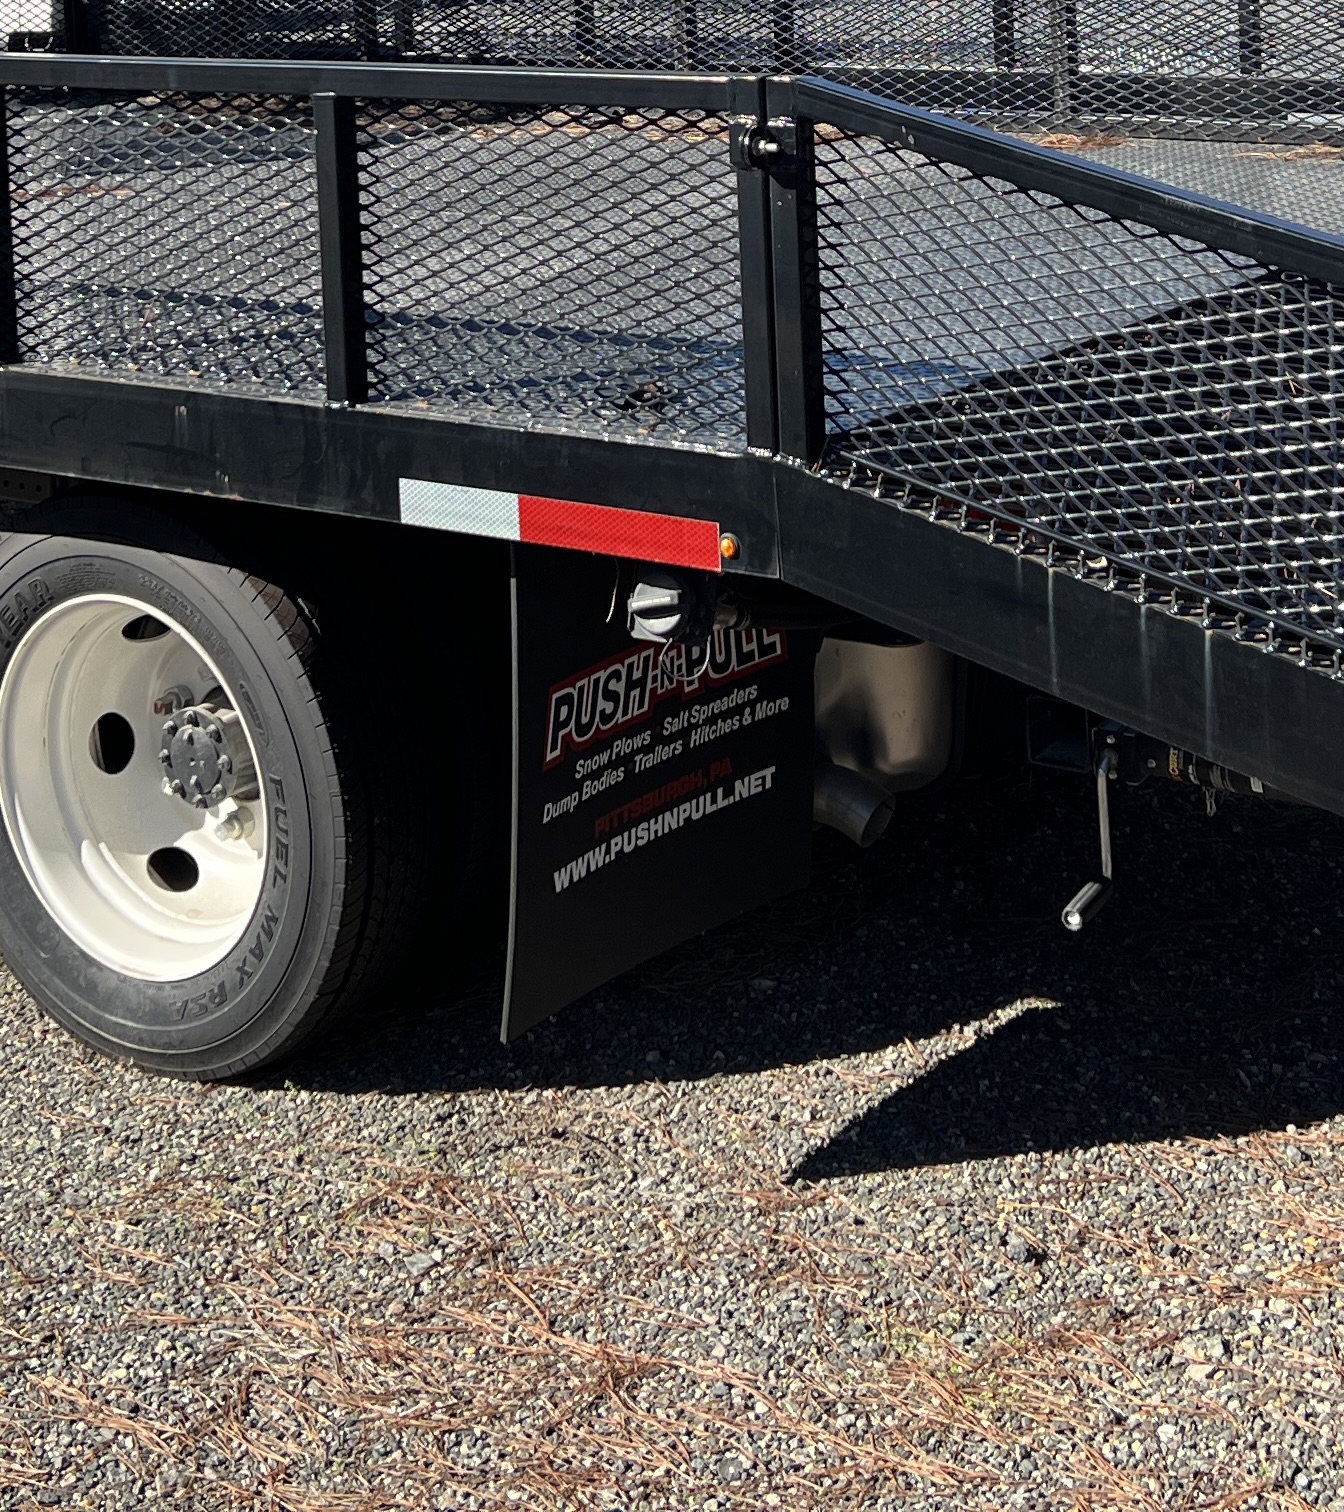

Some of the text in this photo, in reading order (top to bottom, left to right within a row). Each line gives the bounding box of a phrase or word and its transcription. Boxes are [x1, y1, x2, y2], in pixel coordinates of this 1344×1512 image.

[543, 696, 789, 824] Dump Bodies Trailers Hitches & More
[575, 685, 758, 779] Snow Plows Salt Spreaders
[553, 766, 776, 893] WWW.PUSHNPULL.NET
[169, 773, 289, 1022] FUEL MAX RSA
